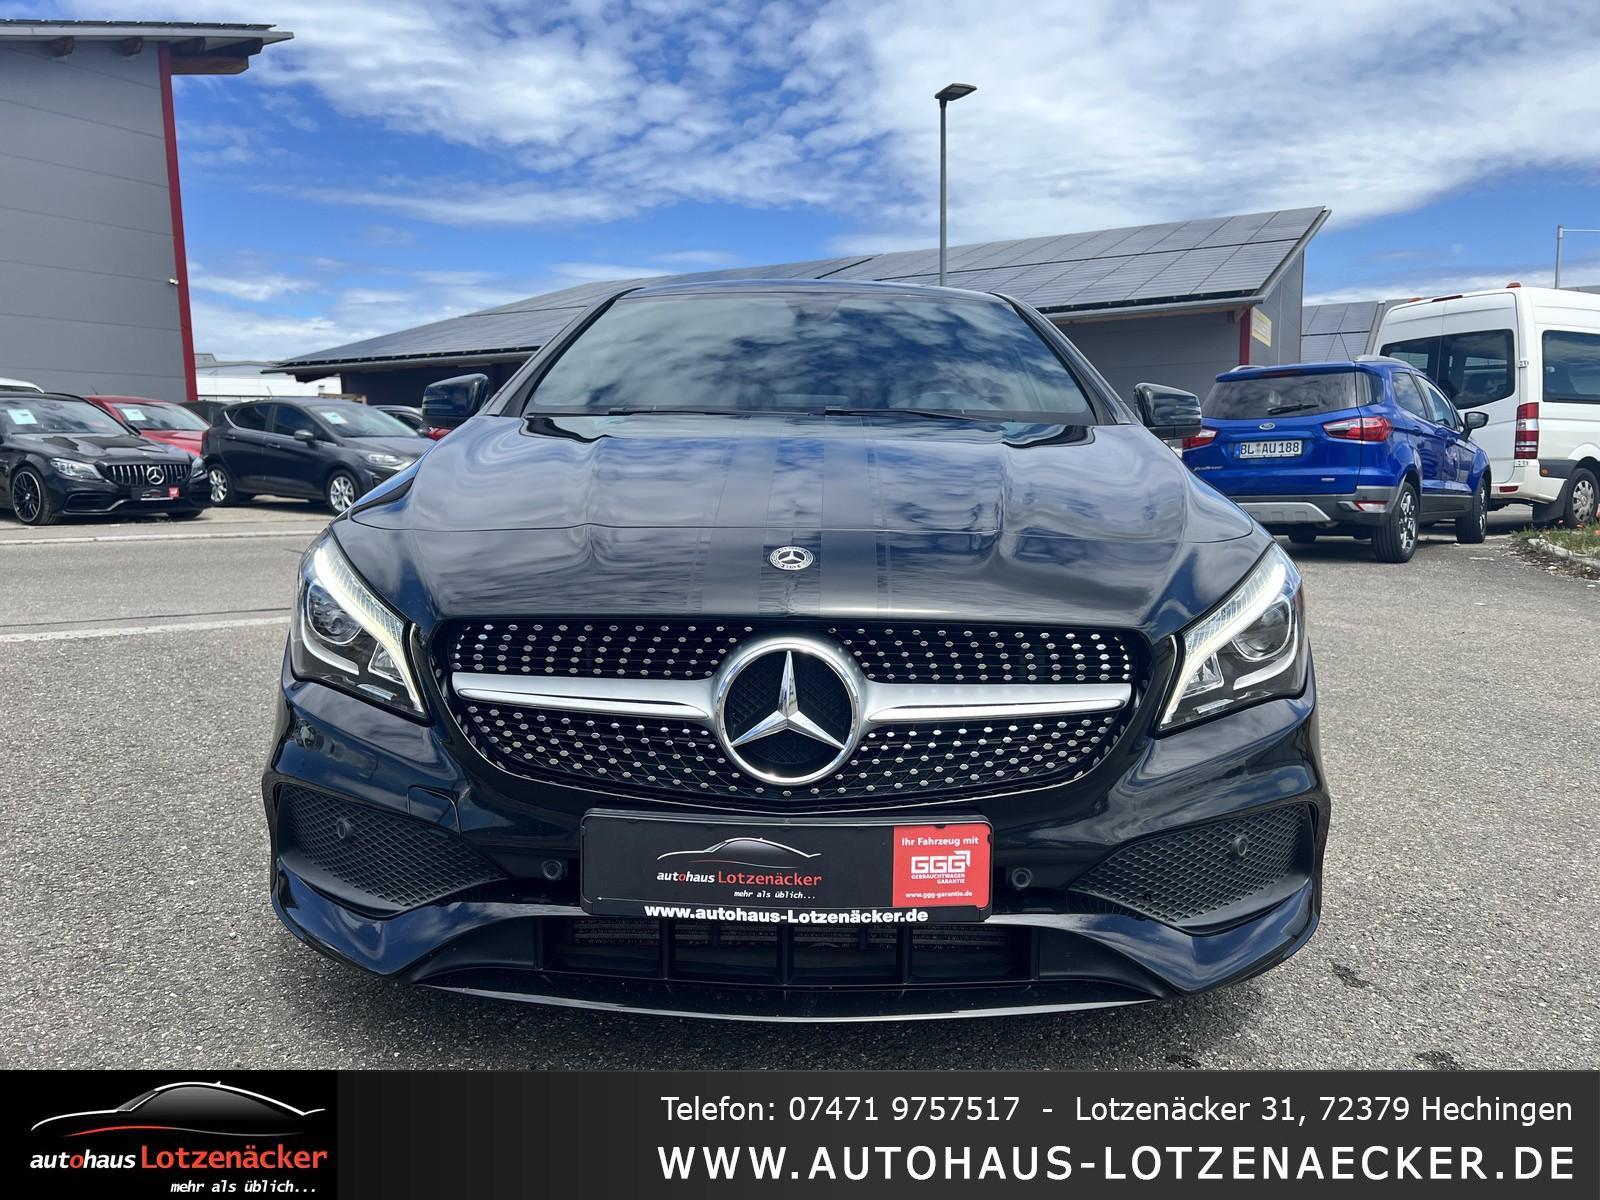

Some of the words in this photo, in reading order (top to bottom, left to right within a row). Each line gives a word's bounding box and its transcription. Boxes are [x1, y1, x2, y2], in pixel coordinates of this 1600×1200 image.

[1240, 443, 1255, 455] BL
[1261, 442, 1277, 454] AU
[1279, 441, 1300, 454] 188
[901, 837, 915, 846] Ihr
[917, 836, 961, 847] Fahrzeug
[962, 836, 979, 845] mit
[911, 855, 966, 873] GGG
[656, 871, 715, 883] autohaus
[717, 870, 822, 886] Lotzenäcker
[733, 890, 753, 898] mehr
[756, 890, 771, 898] als
[774, 890, 816, 899] üblich...
[905, 890, 973, 899] www.ggg-garantie.de
[644, 905, 928, 924] www.autohaus-Lotzenäcker.de
